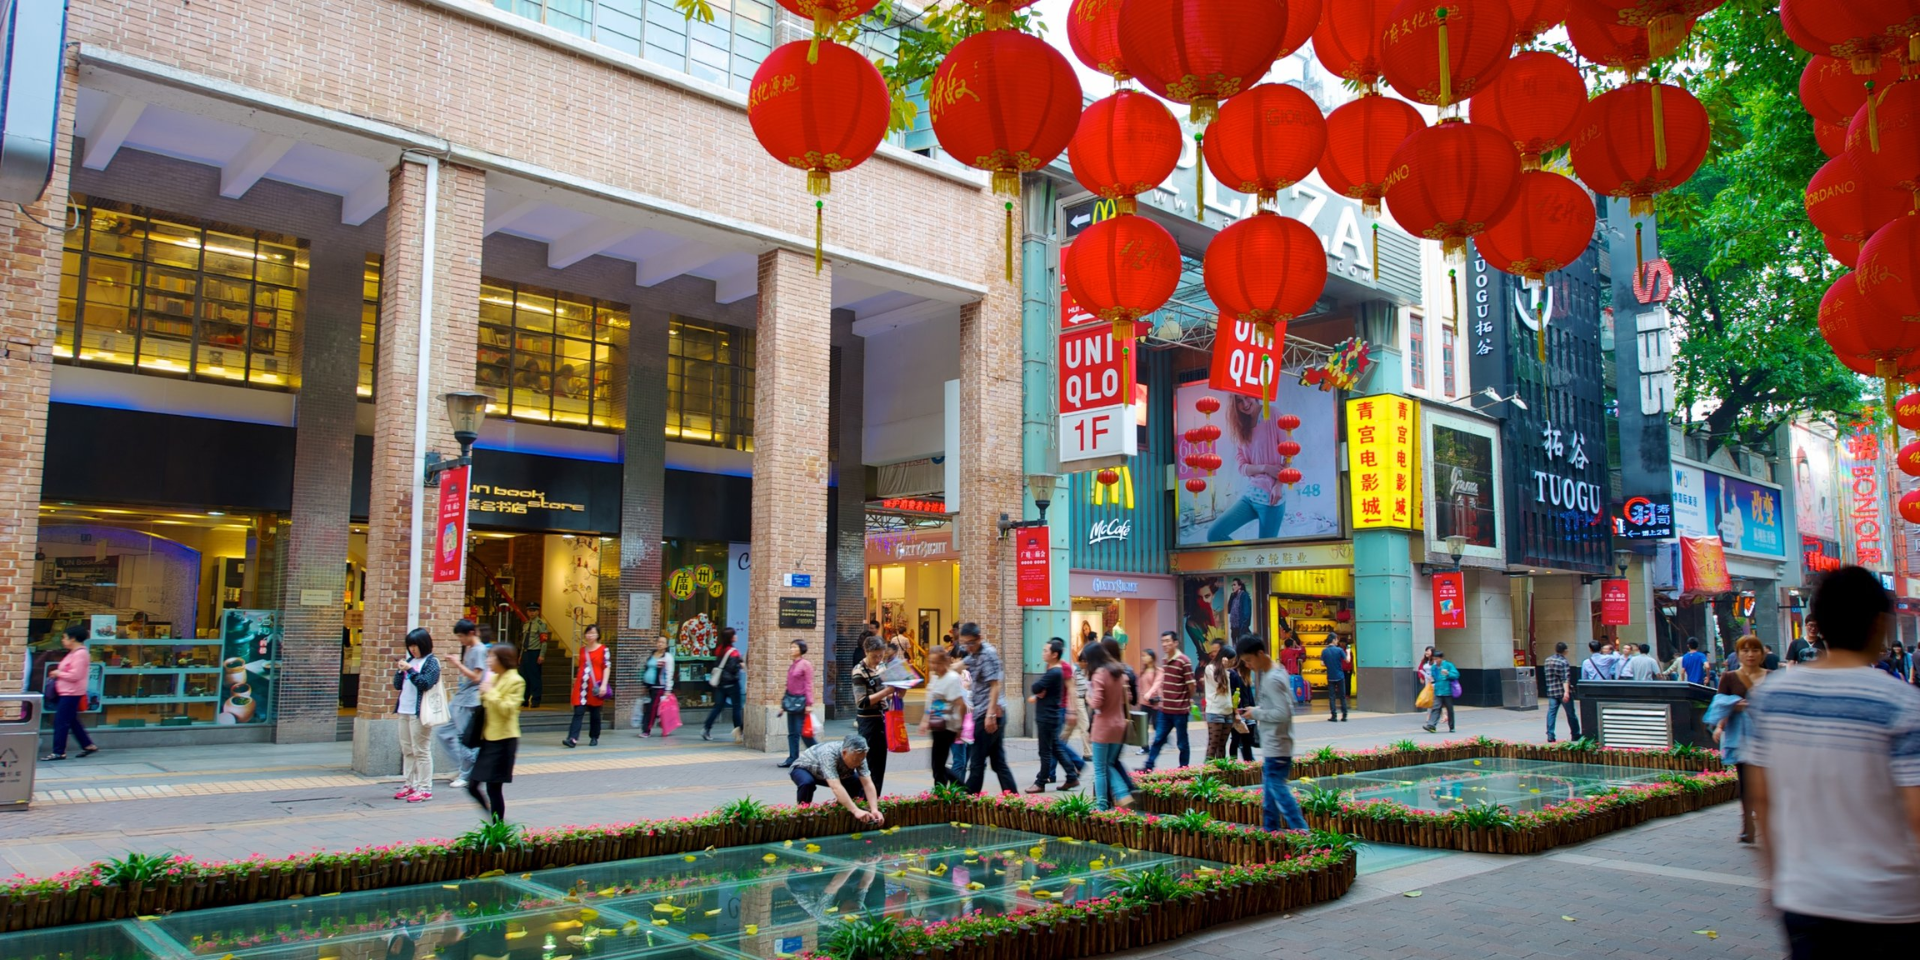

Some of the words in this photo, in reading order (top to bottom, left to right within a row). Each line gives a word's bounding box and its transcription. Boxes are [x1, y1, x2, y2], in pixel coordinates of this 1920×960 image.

[1065, 333, 1113, 368] UNI
[1475, 320, 1494, 356] 拓谷
[1229, 348, 1275, 387] QLO
[1065, 368, 1119, 408] QLO
[1074, 415, 1111, 452] 1F
[1543, 420, 1589, 470] 拓谷
[1355, 401, 1381, 516] 青宫电影城
[1394, 401, 1408, 516] 青宫电影城
[493, 485, 545, 499] book
[528, 496, 585, 512] store
[1534, 470, 1600, 515] TUOGU
[1750, 489, 1775, 527] 改变
[1089, 517, 1132, 543] McCafé
[1850, 465, 1882, 566] BONJOUR
[1254, 552, 1308, 566] 金轮鞋业
